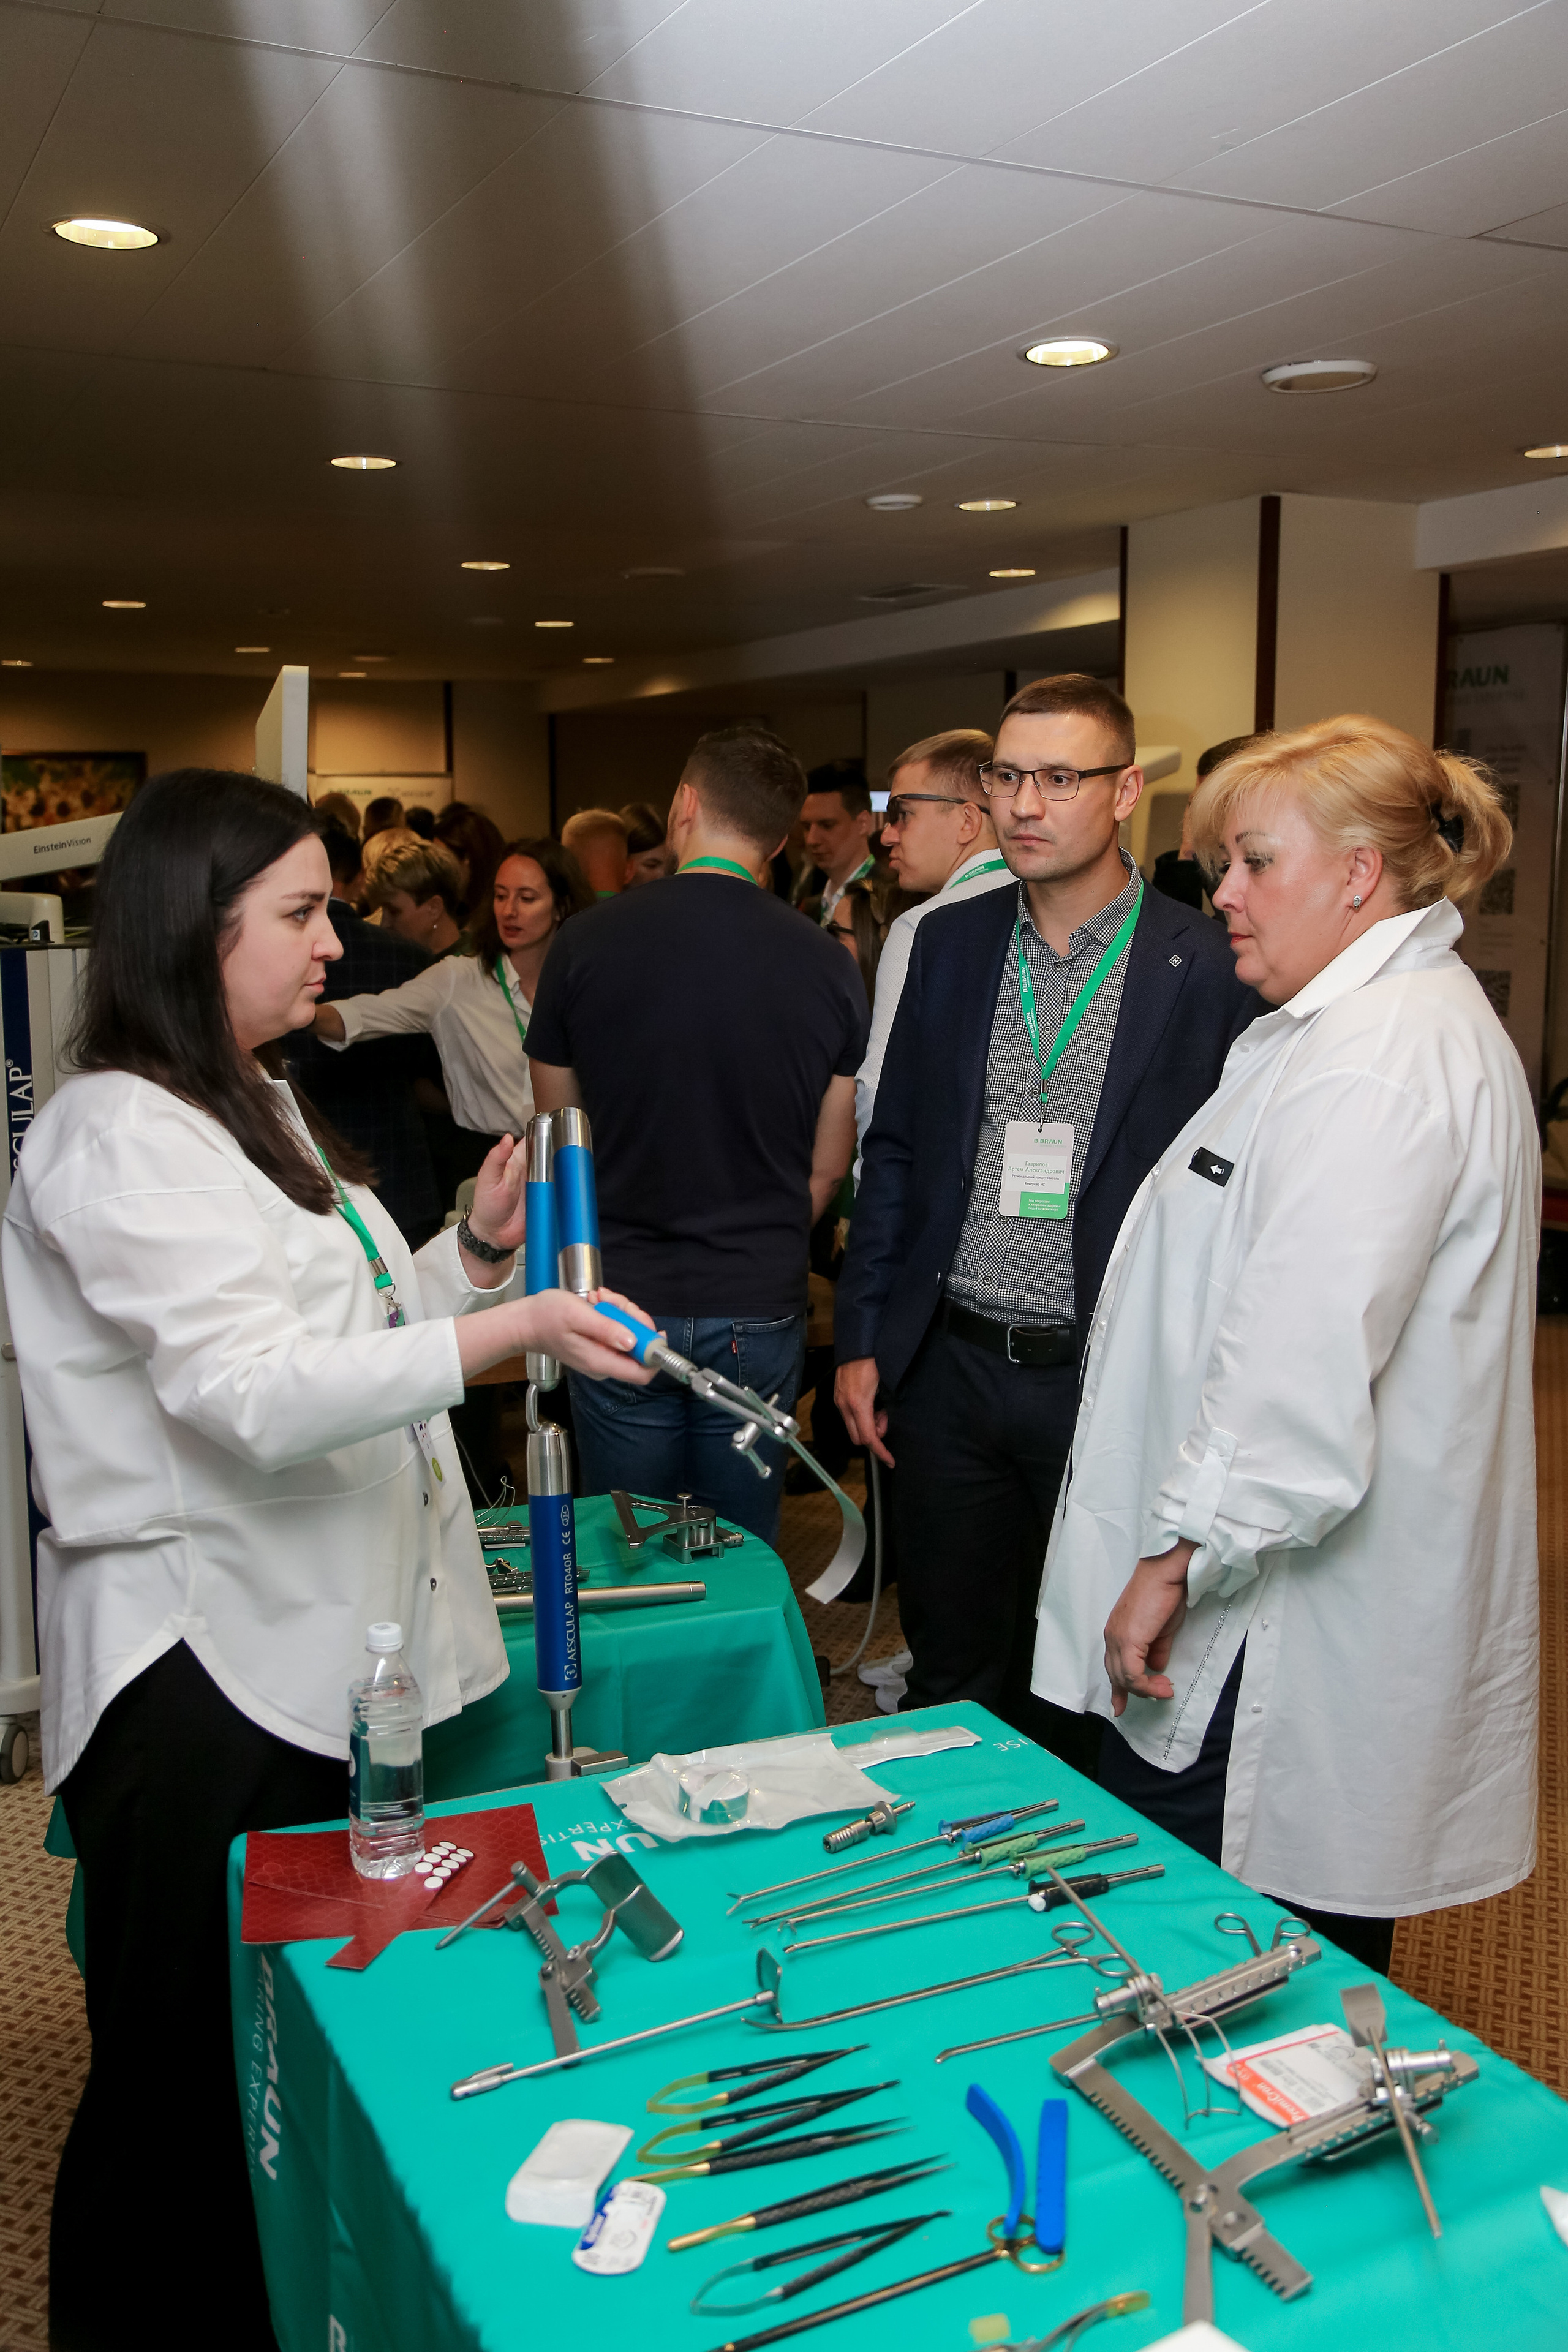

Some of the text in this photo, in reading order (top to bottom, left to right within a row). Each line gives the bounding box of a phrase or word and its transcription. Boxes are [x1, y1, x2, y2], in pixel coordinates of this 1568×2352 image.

[34, 837, 91, 854] EinsteinVision
[565, 1602, 576, 1660] AESCULAP
[260, 1951, 281, 2181] BRAUN
[1257, 2082, 1305, 2121] PremiCron
